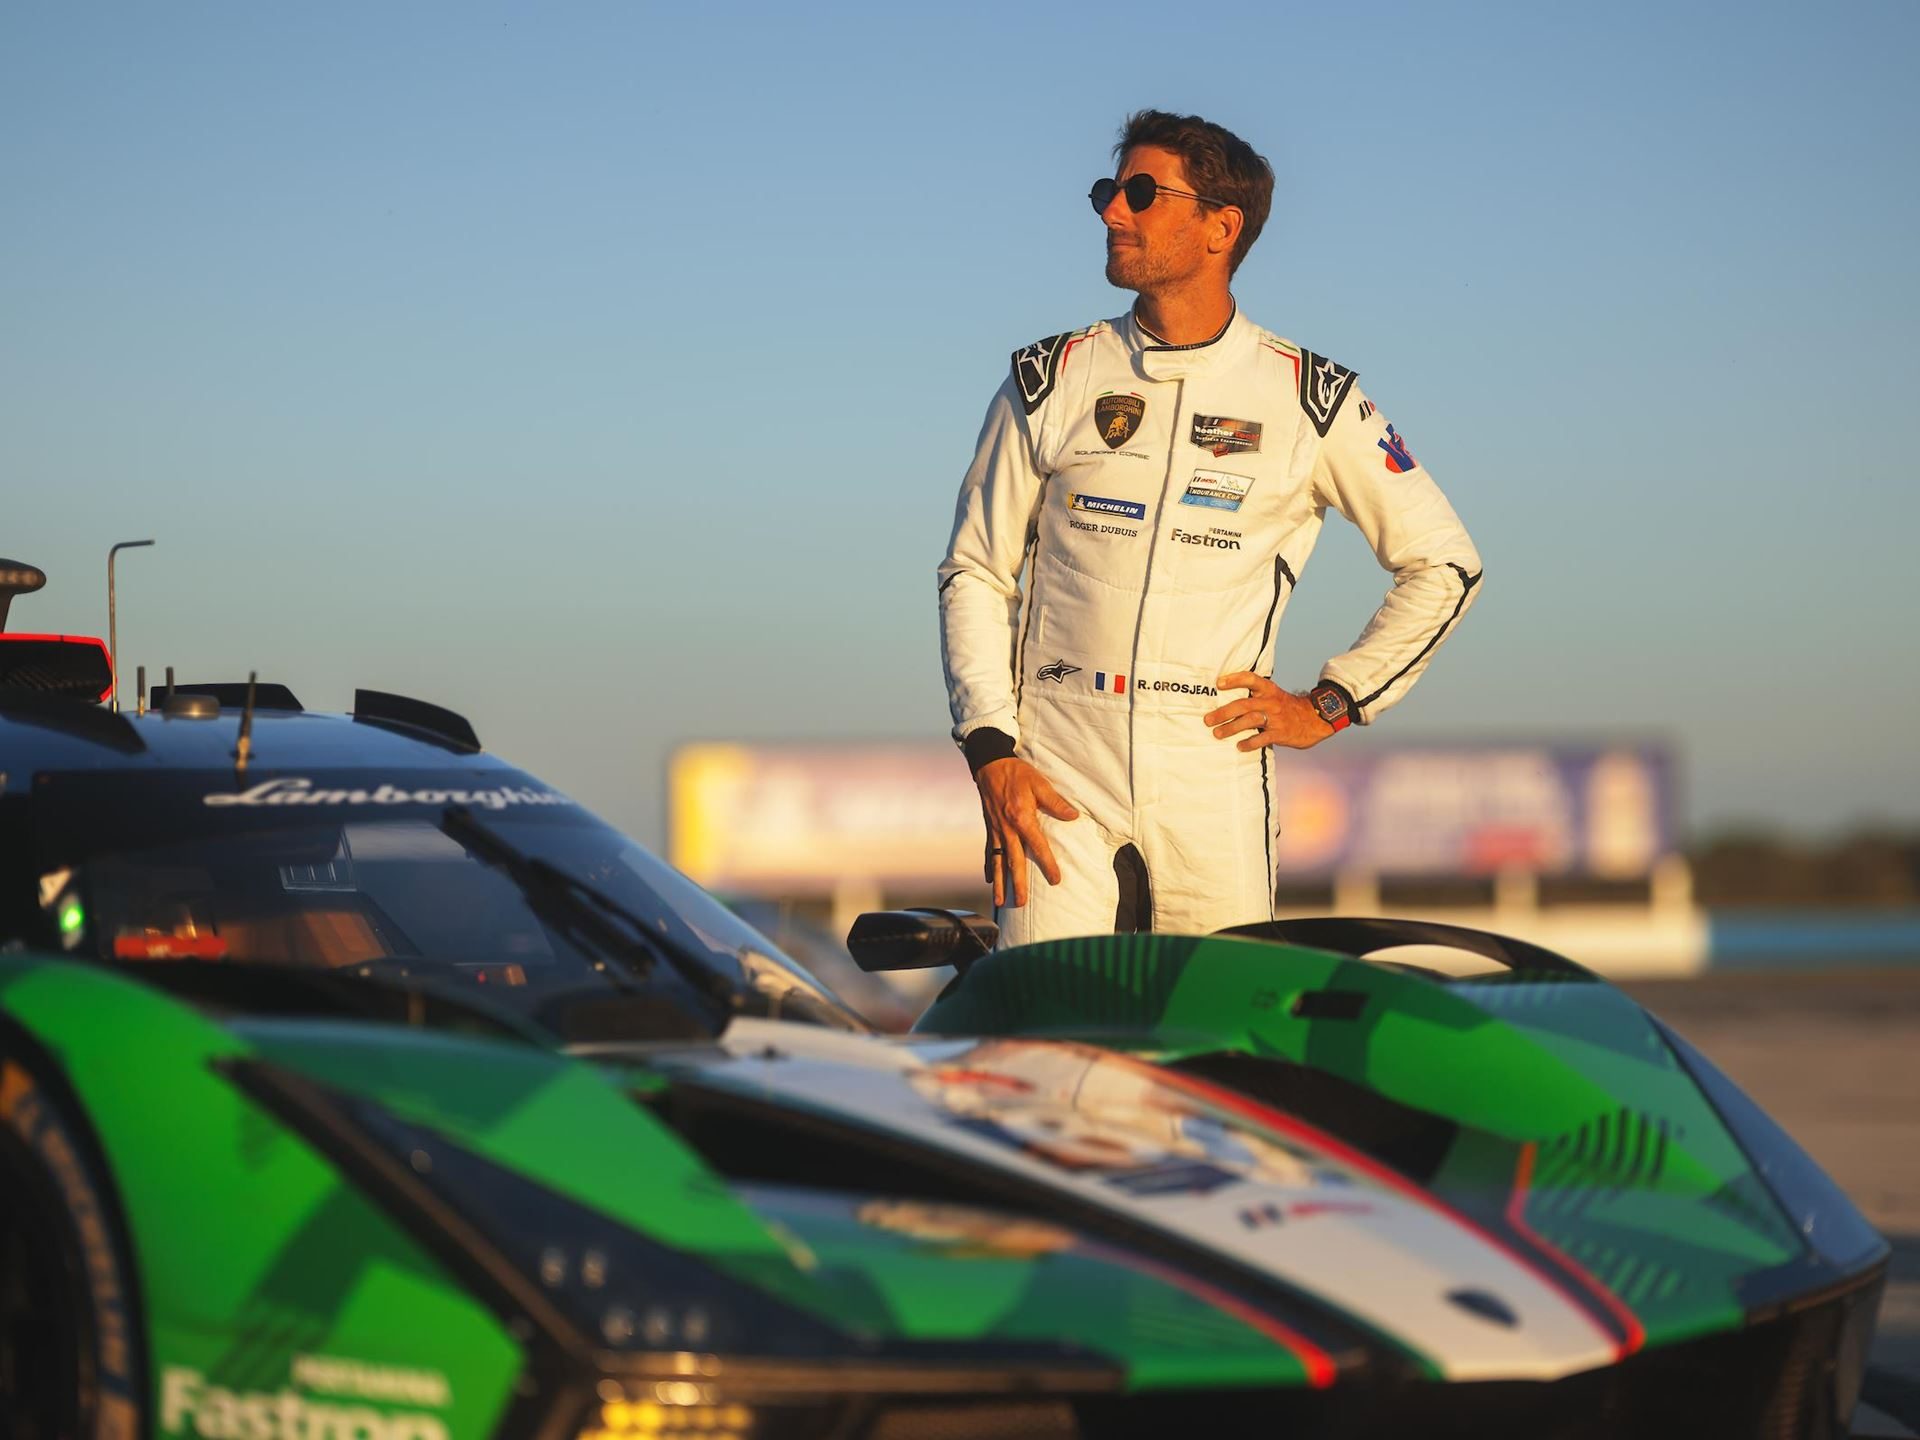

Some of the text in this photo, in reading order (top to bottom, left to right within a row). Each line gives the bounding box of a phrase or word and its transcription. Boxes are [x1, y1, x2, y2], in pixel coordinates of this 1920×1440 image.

[1101, 397, 1140, 408] AUTOMOBILI
[1097, 404, 1142, 416] LAMBORGHINI
[1119, 451, 1150, 460] CORSE
[1086, 500, 1139, 515] MICHELIN
[1069, 520, 1138, 538] ROGER DUBUIS
[1208, 527, 1242, 538] PERTAMINA
[1171, 528, 1241, 551] Fastron
[1137, 679, 1218, 697] R. GROSJEAN
